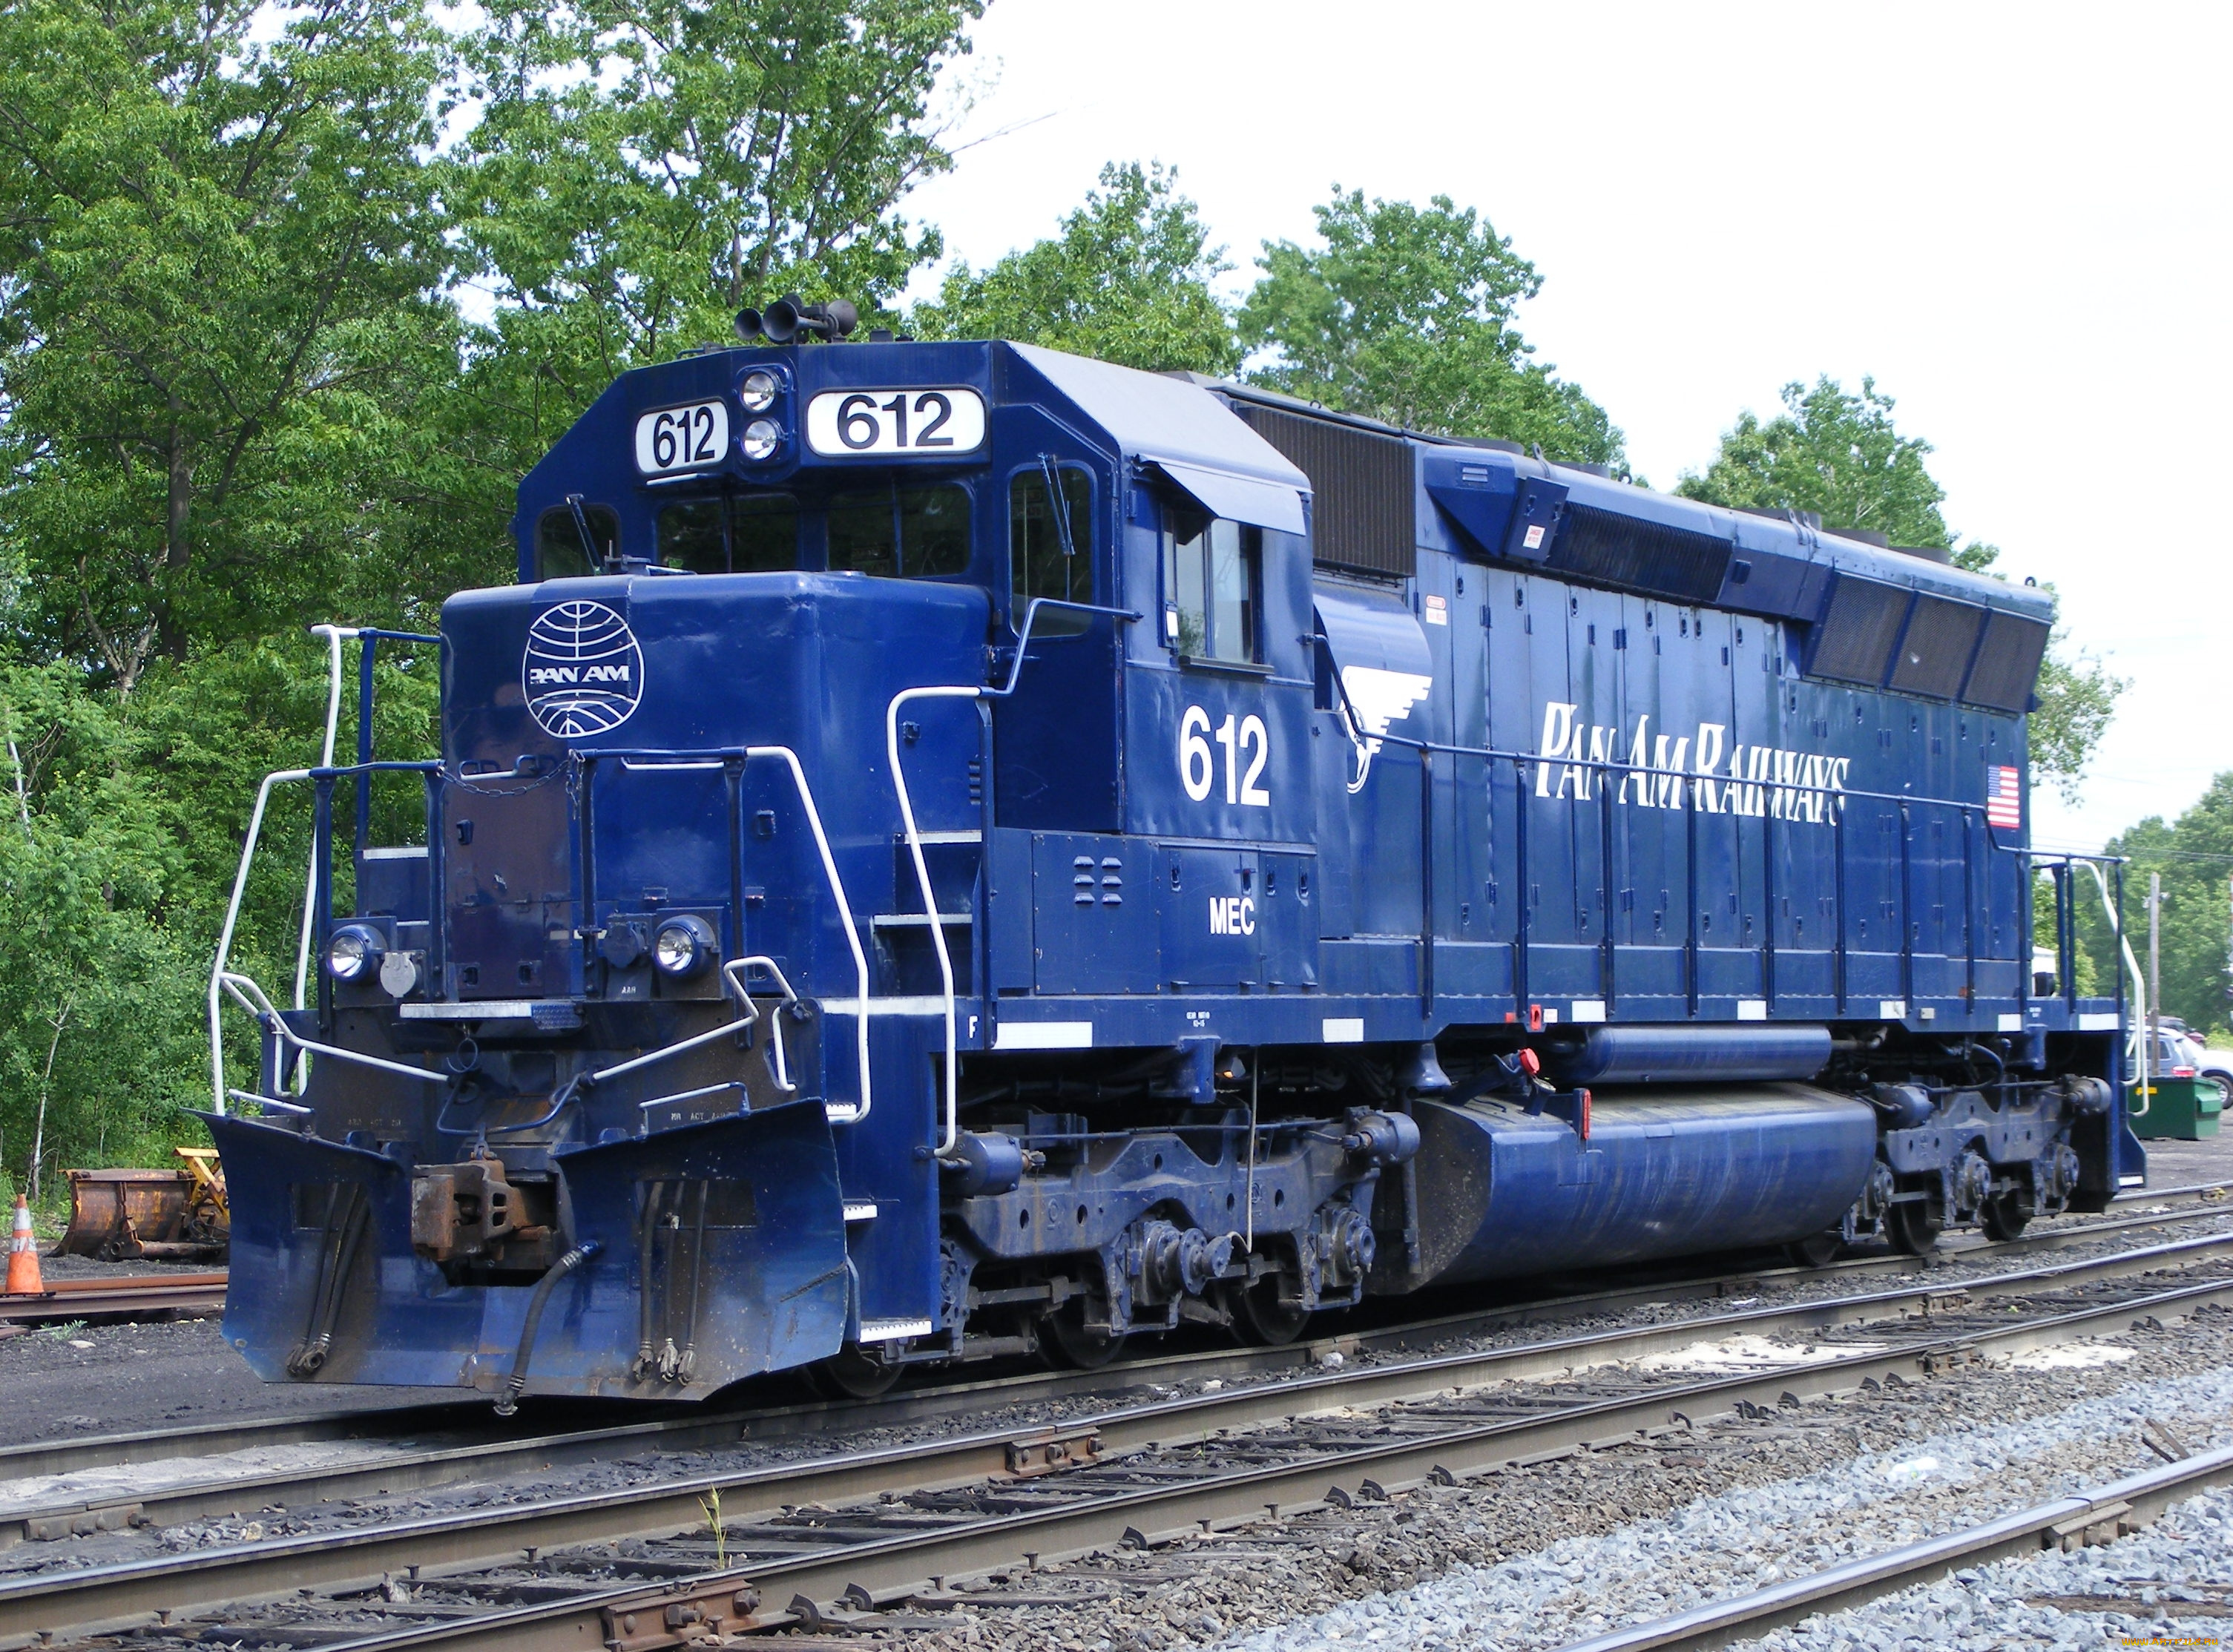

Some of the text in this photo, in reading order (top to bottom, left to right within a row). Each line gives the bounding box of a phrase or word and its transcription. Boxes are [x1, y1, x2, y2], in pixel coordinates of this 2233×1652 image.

[653, 407, 715, 468] 612
[837, 392, 954, 450] 612
[530, 665, 629, 684] PAN AM
[1180, 705, 1270, 807] 612
[1536, 702, 1617, 800] PAN
[1618, 714, 1690, 810] AM
[1209, 897, 1255, 935] MEC
[969, 1016, 978, 1039] F
